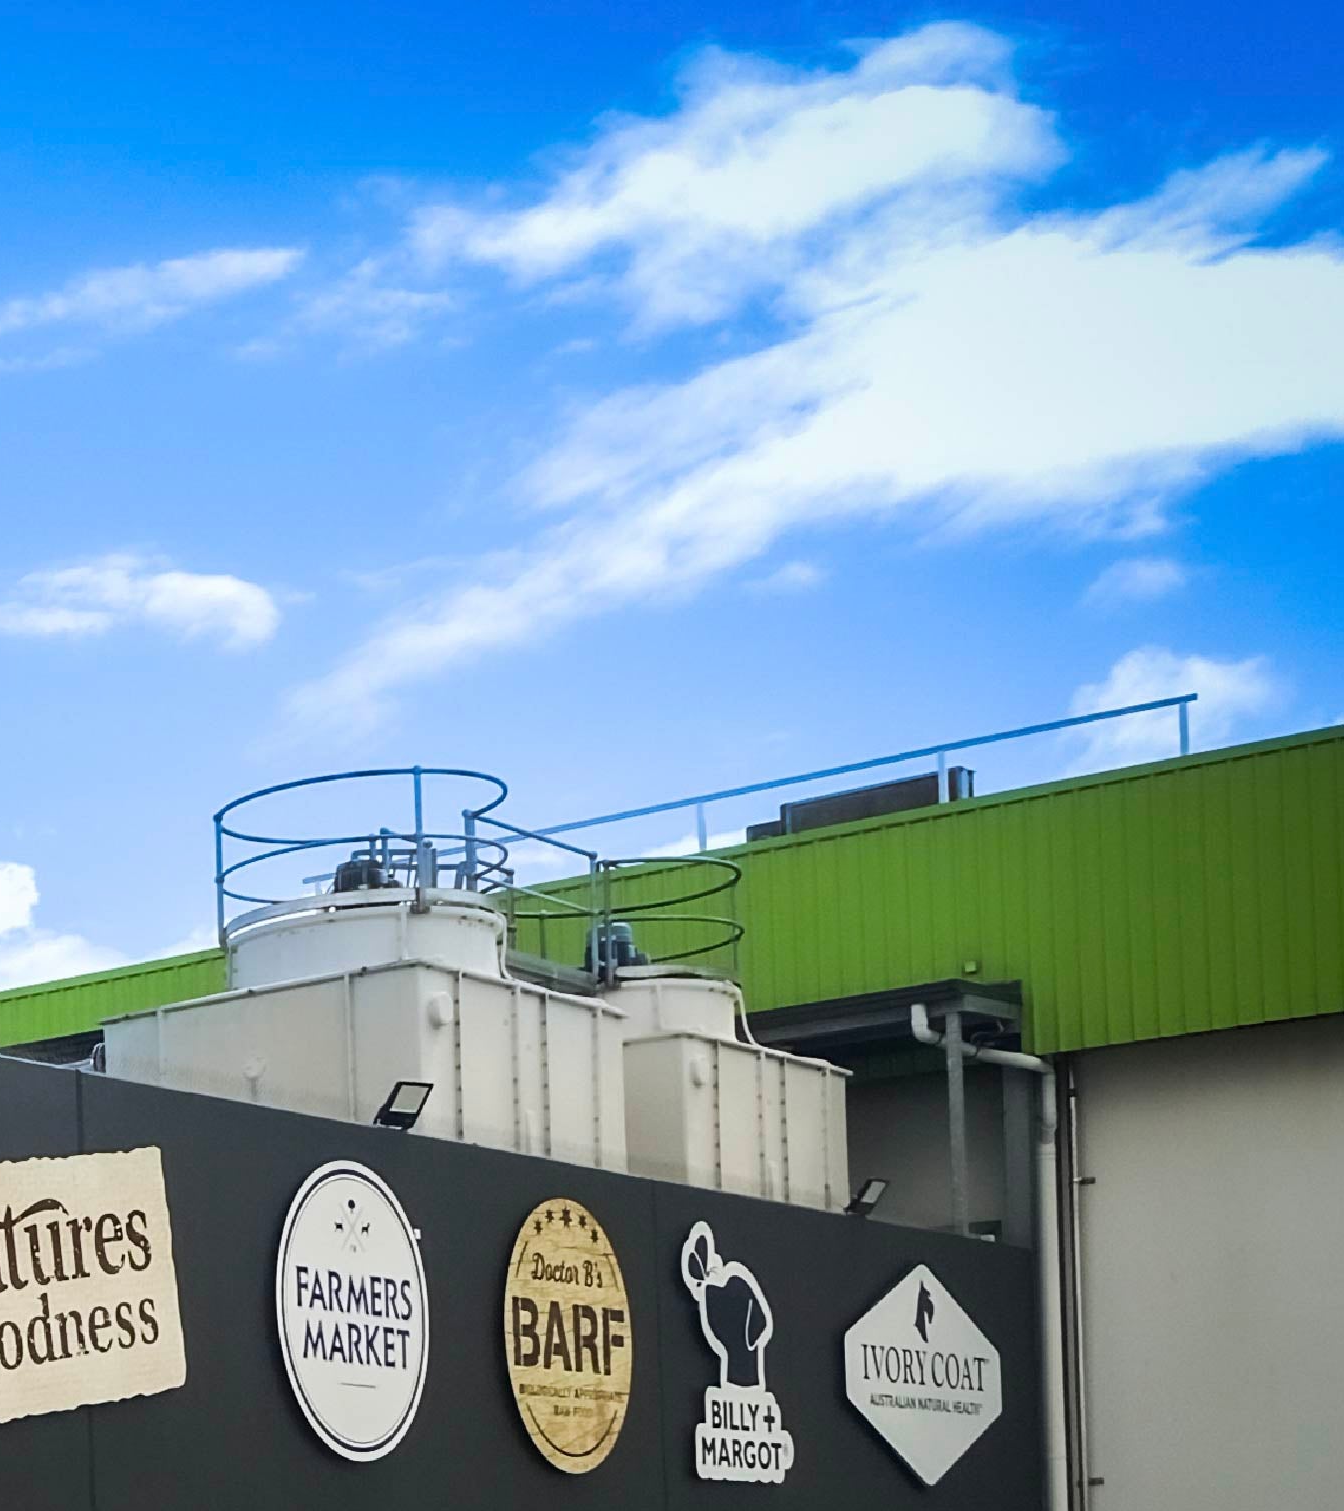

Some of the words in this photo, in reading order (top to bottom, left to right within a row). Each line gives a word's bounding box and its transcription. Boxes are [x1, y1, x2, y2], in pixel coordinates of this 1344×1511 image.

[531, 1252, 580, 1285] Doctor
[295, 1265, 413, 1321] FARMERS
[302, 1319, 410, 1371] MARKET
[511, 1296, 625, 1376] BARF
[860, 1344, 927, 1385] IVORY
[931, 1351, 985, 1391] COAT
[712, 1400, 759, 1432] BILLY
[701, 1436, 782, 1471] MARGOT
